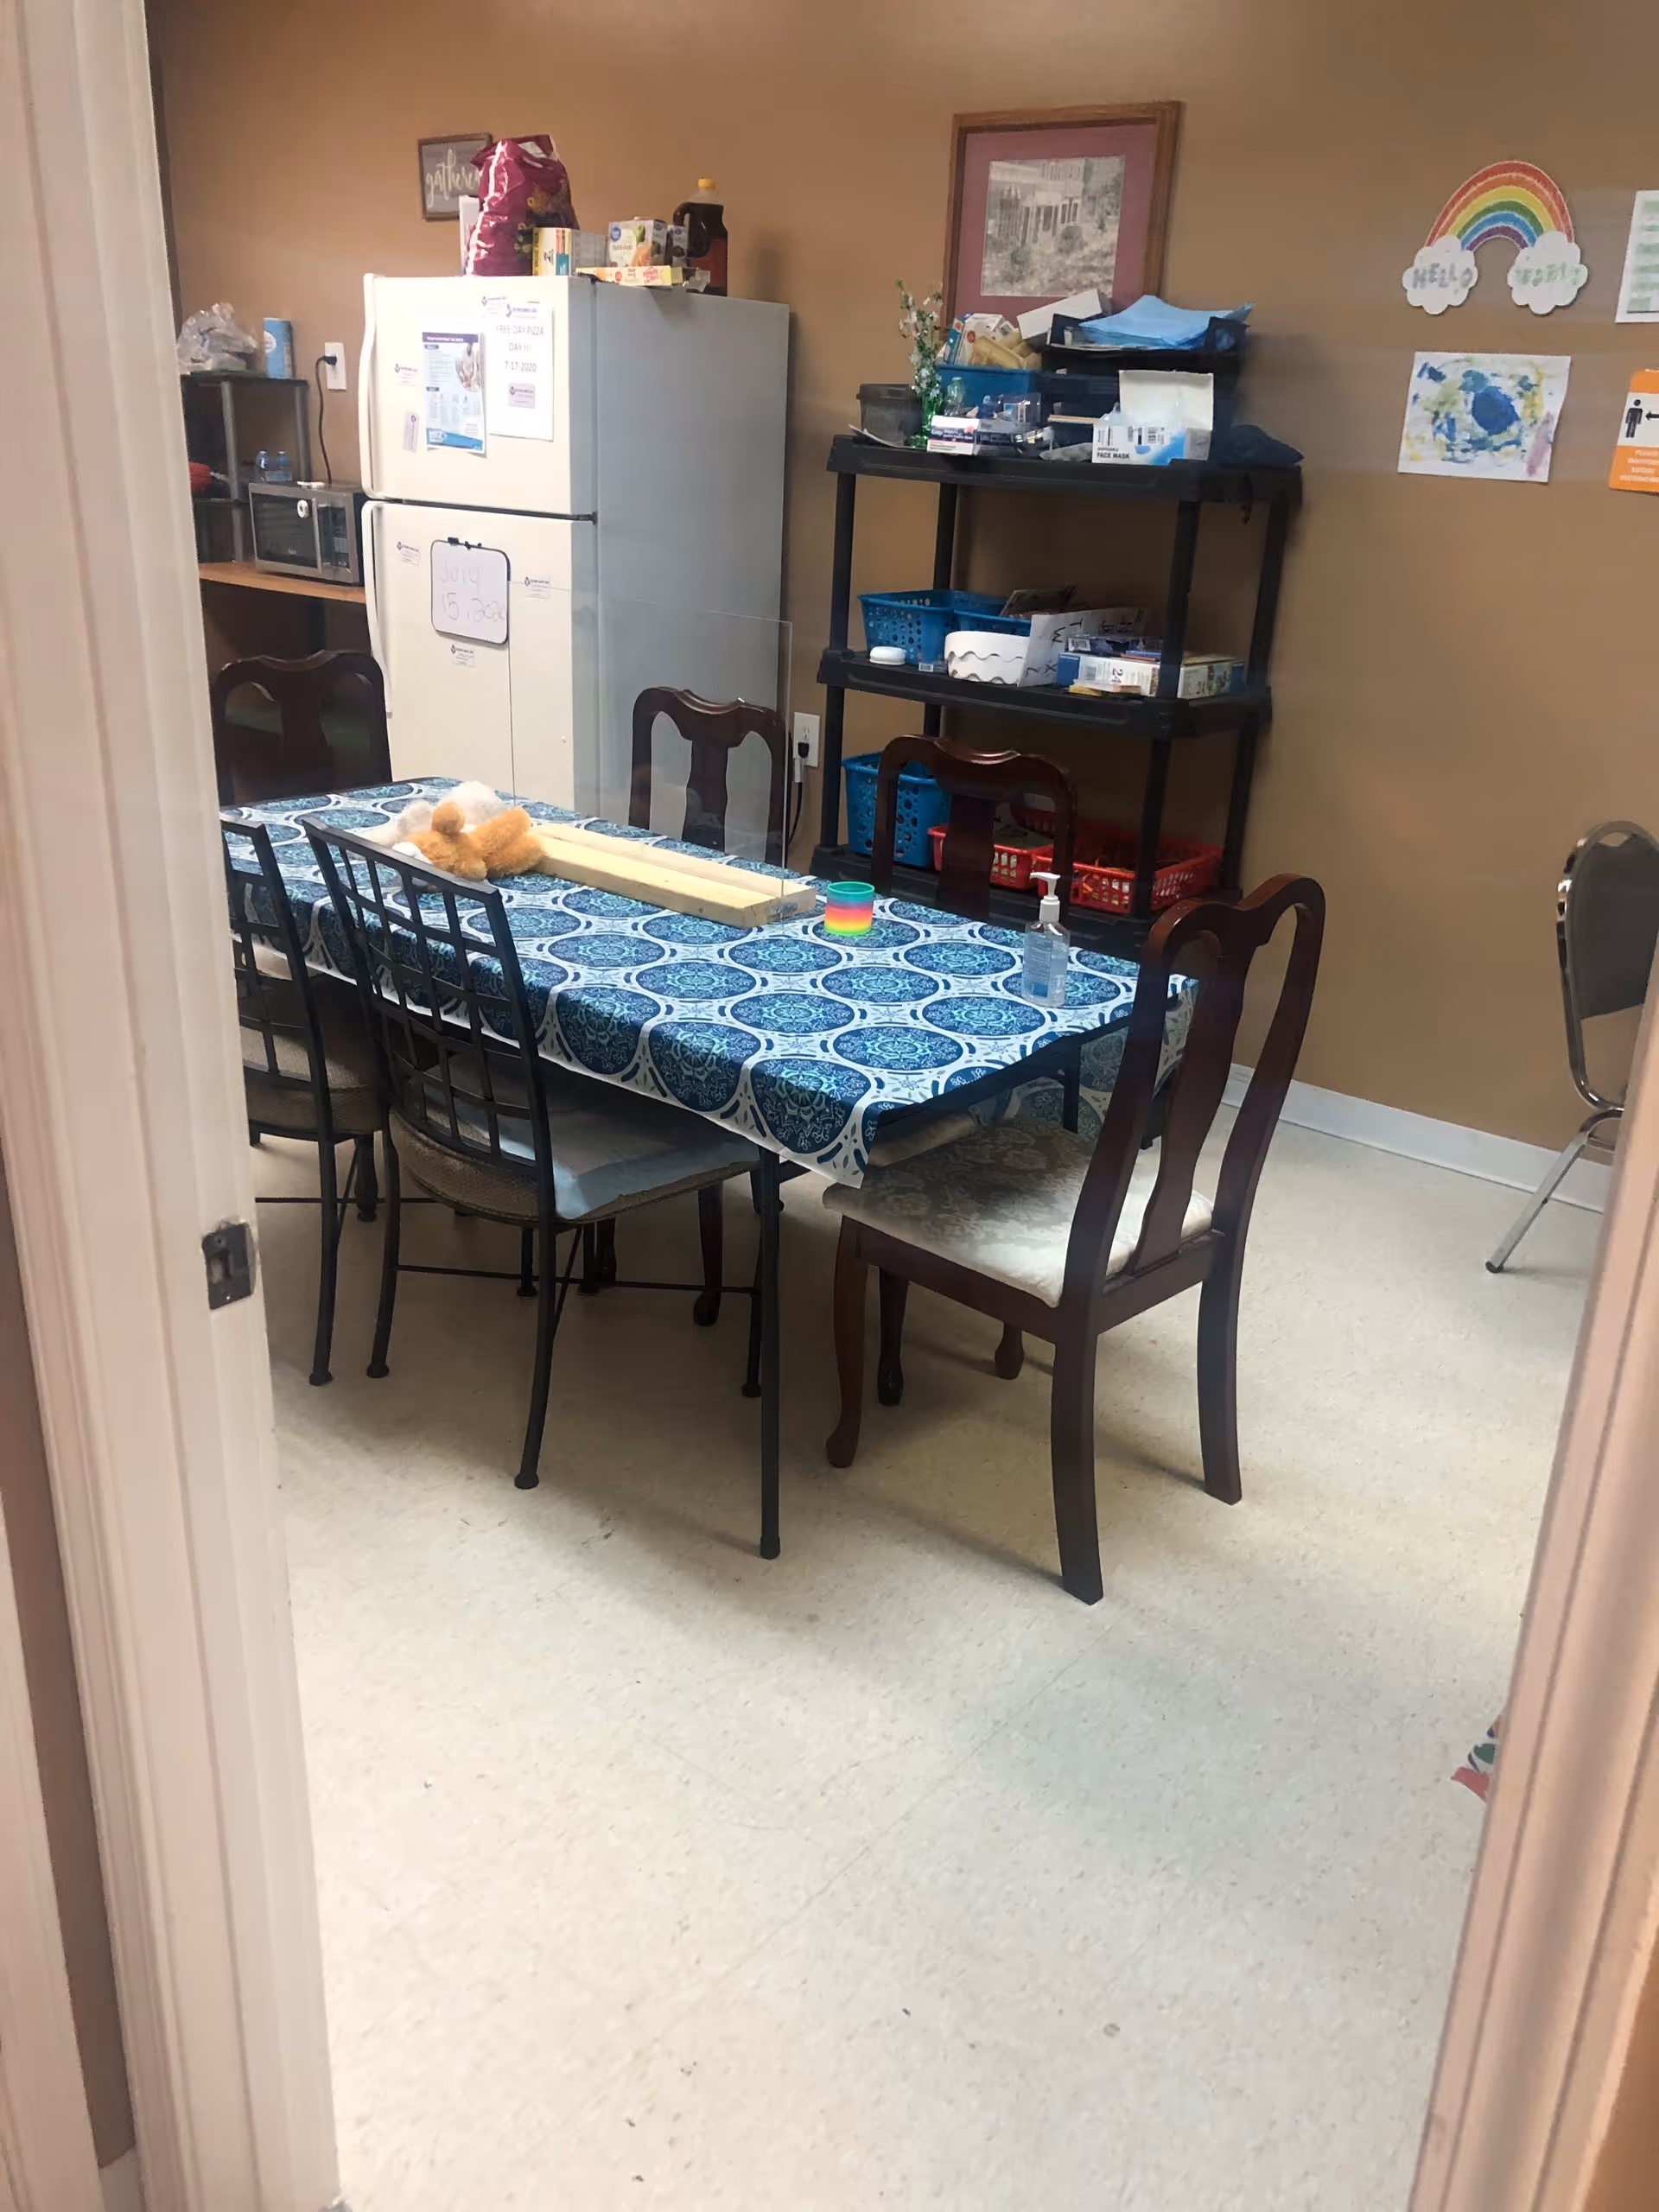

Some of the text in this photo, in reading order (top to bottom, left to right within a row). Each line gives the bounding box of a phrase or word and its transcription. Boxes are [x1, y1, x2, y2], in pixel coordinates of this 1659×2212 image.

[1412, 263, 1473, 289] HELLO
[496, 325, 544, 336] FREE DAY PIZZA
[505, 360, 537, 372] 7-17-2020
[1112, 668, 1123, 685] 24
